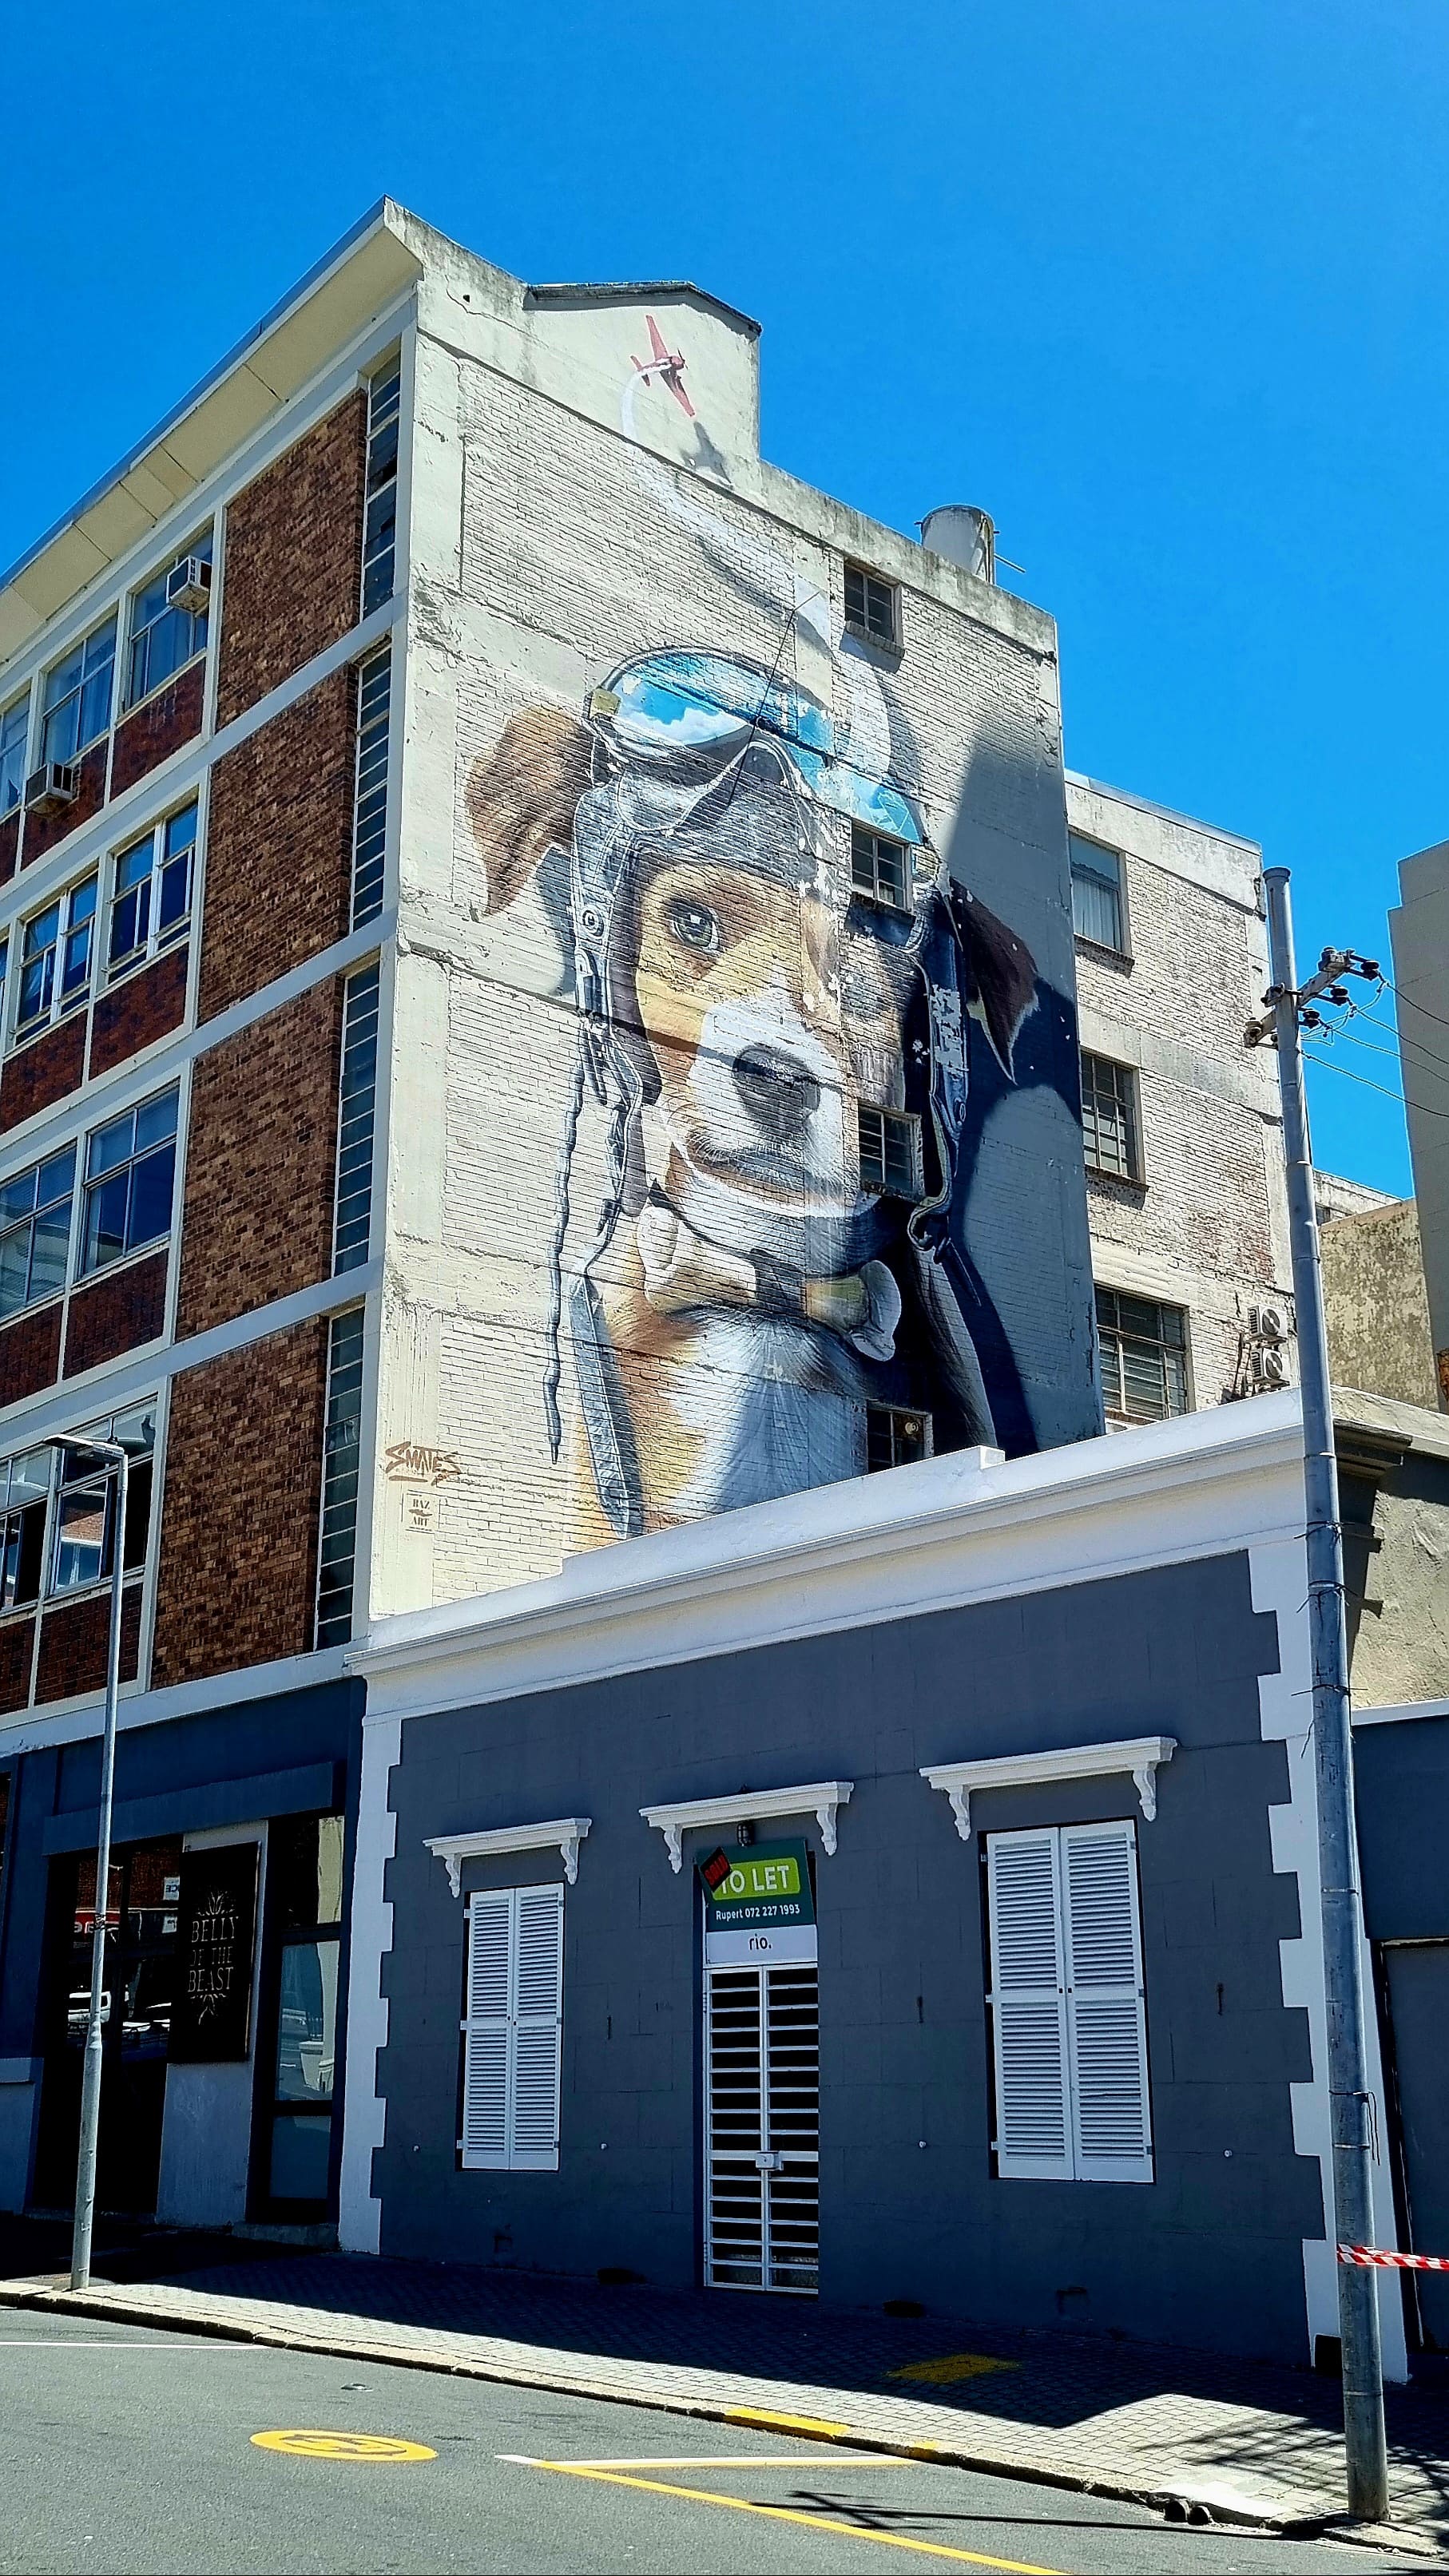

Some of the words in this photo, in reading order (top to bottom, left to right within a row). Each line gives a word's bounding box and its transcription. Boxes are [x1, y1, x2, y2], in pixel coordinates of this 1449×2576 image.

[752, 1865, 789, 1892] LET
[716, 1908, 744, 1922] Rupert
[744, 1907, 760, 1918] 072
[762, 1905, 777, 1916] 227
[779, 1904, 800, 1915] 1993
[192, 1916, 239, 1942] BELLY
[748, 1932, 772, 1951] rio.
[212, 1946, 234, 1965] THE
[188, 1967, 234, 1992] BEAST
